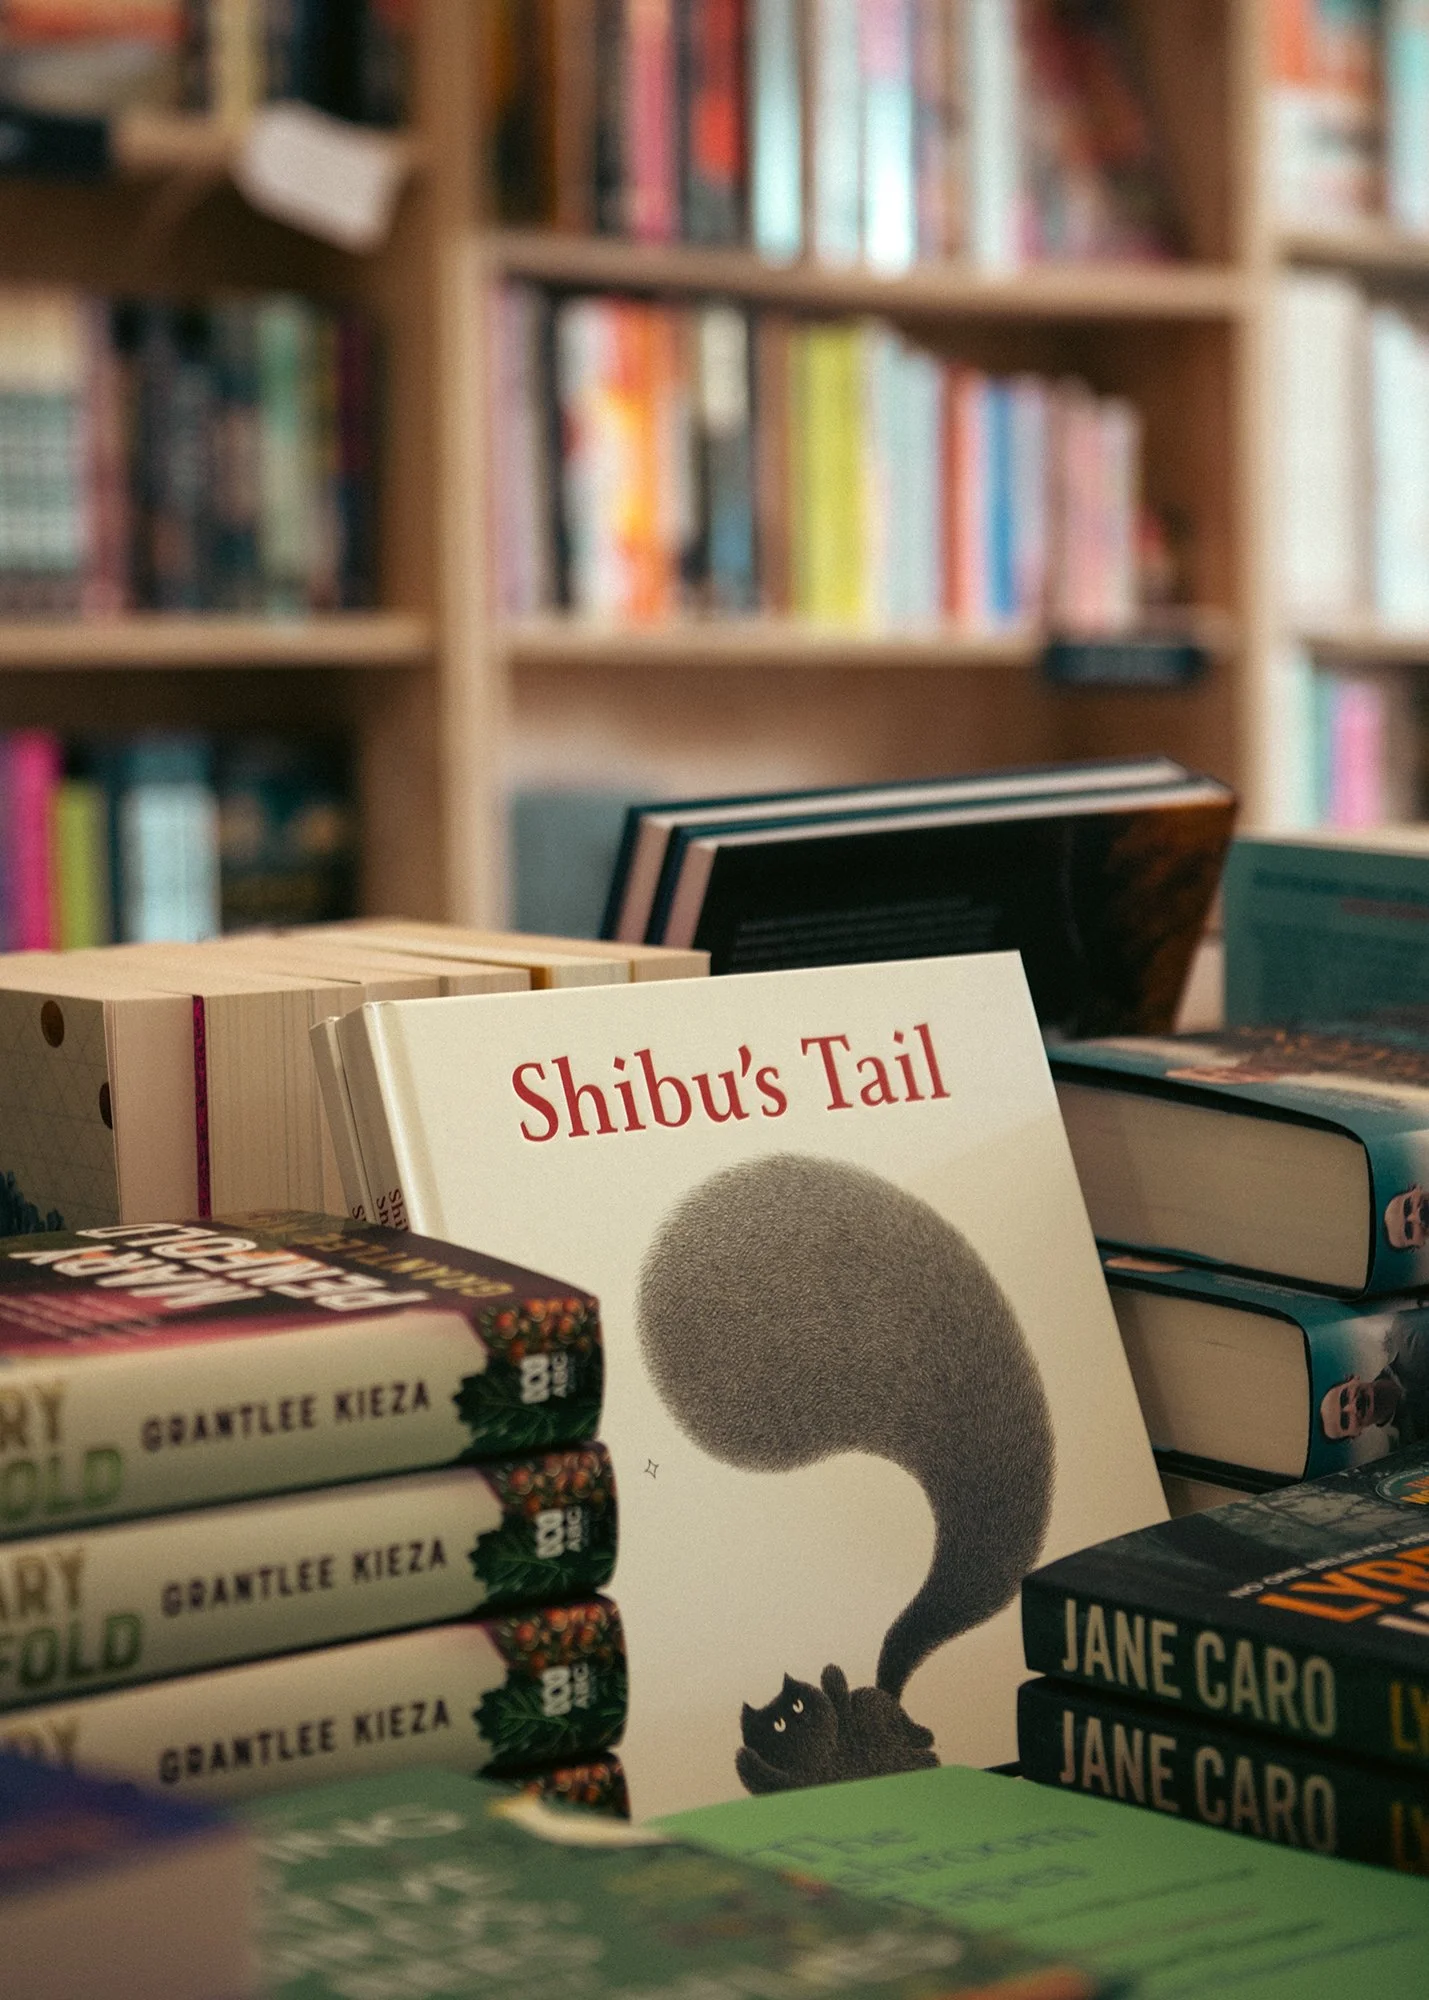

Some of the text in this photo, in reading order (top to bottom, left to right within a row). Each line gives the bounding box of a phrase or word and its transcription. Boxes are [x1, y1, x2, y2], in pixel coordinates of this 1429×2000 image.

[512, 1023, 951, 1142] Shibu's Tail
[8, 1244, 267, 1310] MARY
[76, 1222, 430, 1312] PENFOLD
[142, 1380, 432, 1453] GRANTLEE KIEZA
[161, 1538, 447, 1618] GRANTLEE KIEZA
[1061, 1598, 1337, 1739] JANE CARO
[158, 1698, 452, 1785] GRANTLEE KIEZA
[1058, 1710, 1337, 1853] JANE CARO
